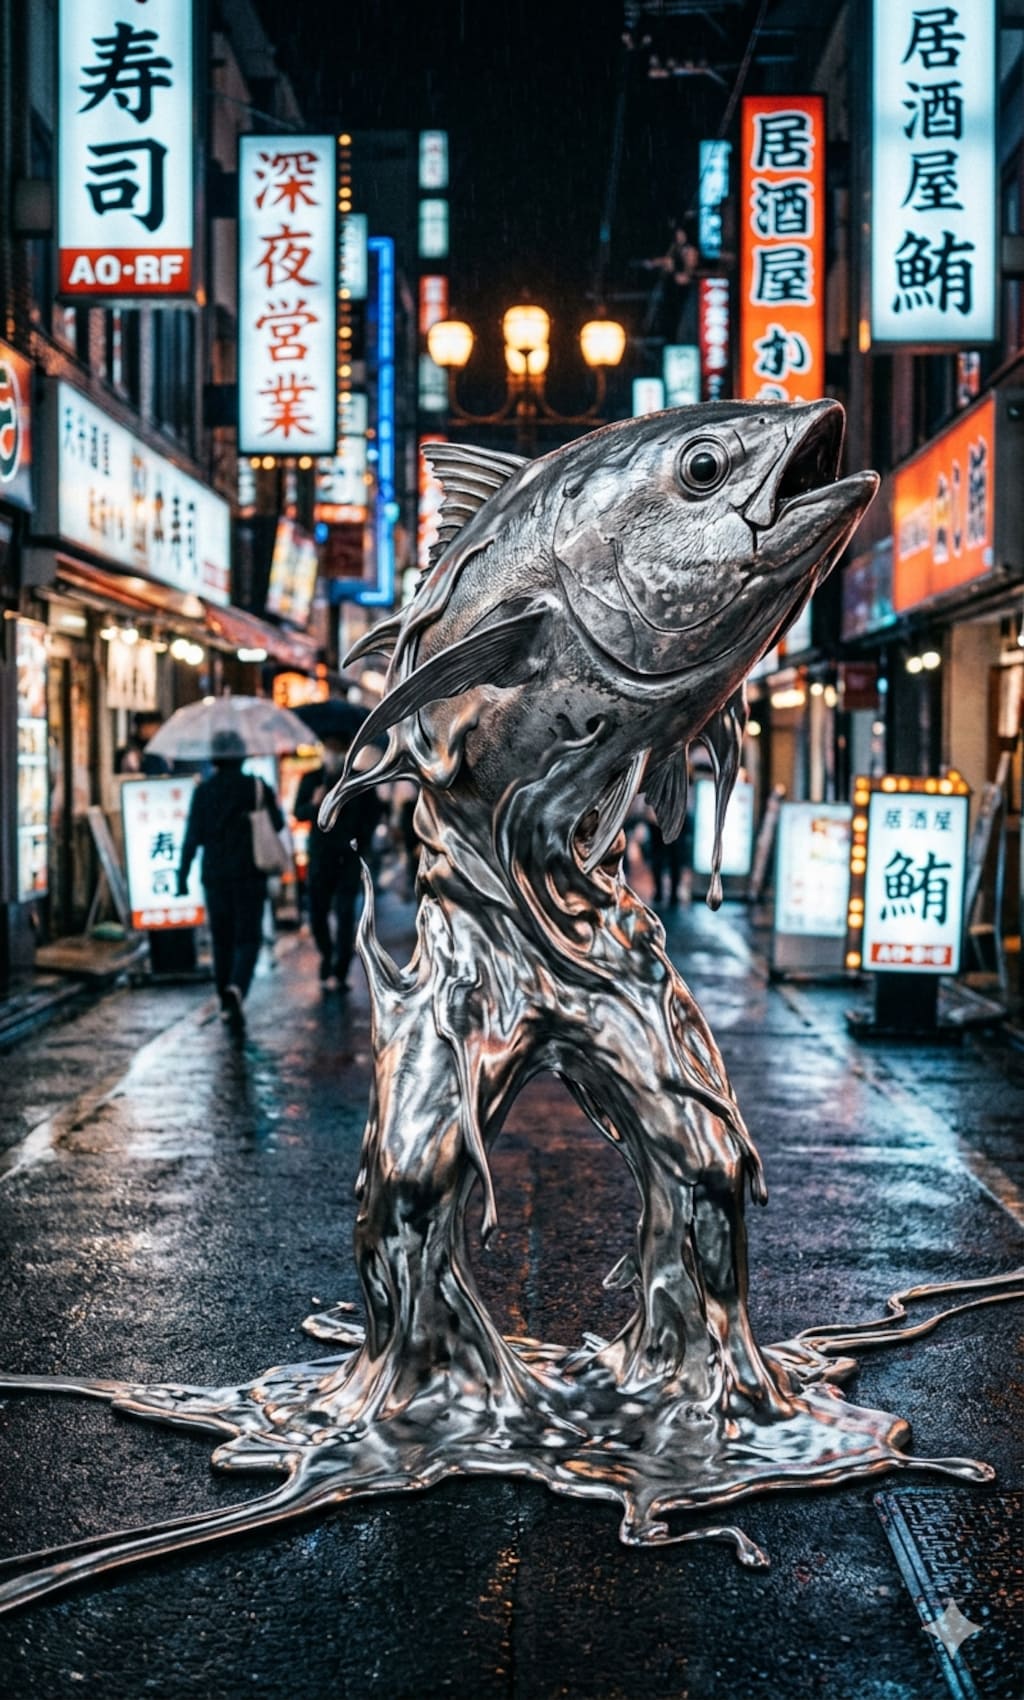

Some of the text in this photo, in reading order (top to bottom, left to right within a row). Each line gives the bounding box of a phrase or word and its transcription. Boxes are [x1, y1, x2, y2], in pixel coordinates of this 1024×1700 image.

[77, 22, 173, 232] 寿司
[254, 150, 320, 439] 深夜営業
[879, 850, 953, 926] 鮪
